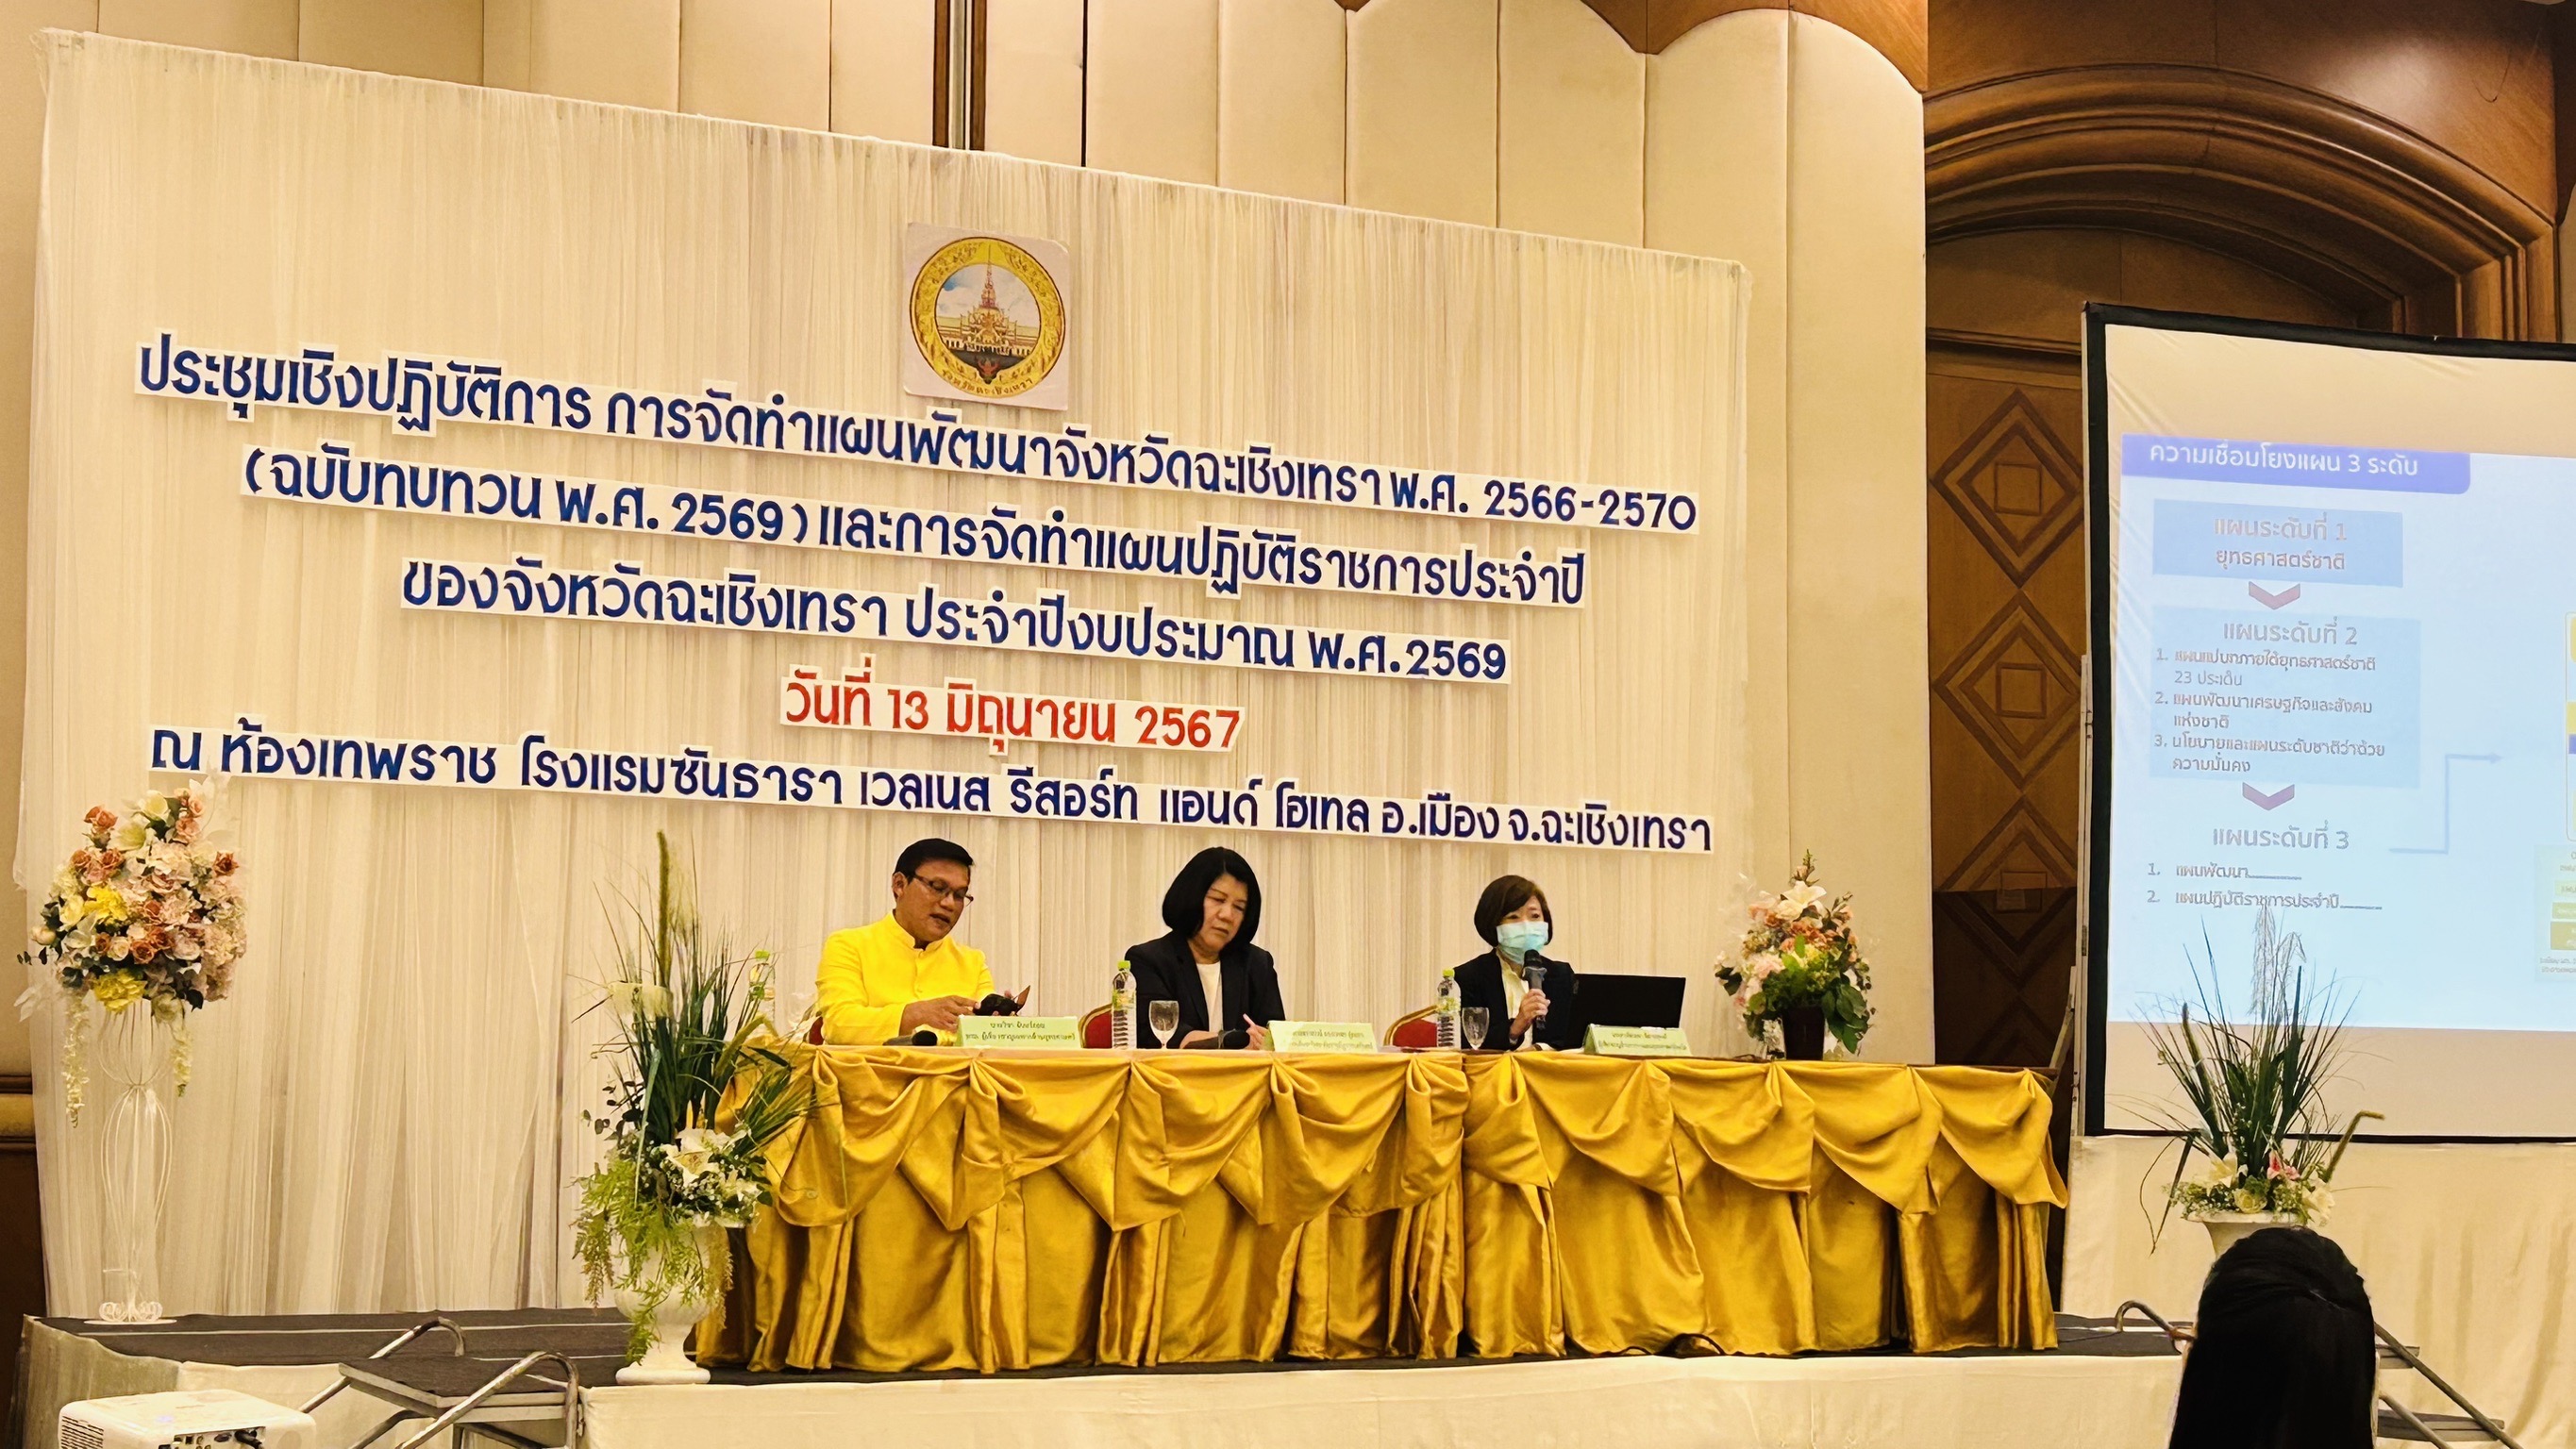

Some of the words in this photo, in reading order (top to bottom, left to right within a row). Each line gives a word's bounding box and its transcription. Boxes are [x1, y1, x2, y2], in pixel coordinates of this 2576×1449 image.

[141, 335, 591, 432] ประชุมเชิงปฏิบัติการ
[608, 390, 1380, 503] การจัดทำแผนพัฒนาจังหวัดฉะเชิงเทรา
[1391, 475, 1468, 512] พ.ศ.
[1485, 480, 1696, 530] 2566-2570
[2149, 440, 2341, 472] ความเชื่อมโยงแผน
[2348, 454, 2361, 473] 3
[2368, 453, 2418, 475] ระดับ
[2213, 512, 2329, 541] แผนระดับที่
[2335, 522, 2348, 541] 1
[557, 482, 659, 529] พ.ศ.
[819, 507, 1584, 605] และการจัดทำแผนปฏิบัติราชการประจำปี
[2215, 548, 2346, 570] ยุทธศาสตร์ชาติ
[403, 558, 887, 636] ของจังหวัดฉะเชิงเทรา
[906, 588, 1294, 667] ประจำปีงบประมาณ
[2222, 615, 2338, 644] แผนระดับที่
[2345, 626, 2359, 645] 2
[2173, 670, 2193, 684] 23
[2197, 669, 2244, 686] ประเด็น
[786, 657, 873, 726] วันที่
[888, 689, 928, 730] 13
[946, 682, 1115, 752] มิถุนายน
[1134, 706, 1240, 748] 2567
[2154, 691, 2168, 705] 2.
[2153, 734, 2167, 747] 3.
[152, 729, 202, 771] ณ
[221, 717, 496, 784] ห้องเทพราช
[522, 735, 842, 803] โรงแรมซันธารา
[861, 772, 990, 811] เวลเนส
[1008, 768, 1138, 819] รีสอร์ท
[1161, 778, 1262, 824] แอนด์
[1276, 781, 1369, 830] โฮเทล
[1382, 793, 1498, 840] อ.เมือง
[1510, 803, 1712, 851] จ.ฉะเชิงเทรา
[2212, 819, 2330, 849] แผนระดับที่
[2334, 830, 2350, 849] 3
[2147, 862, 2161, 876] 1.
